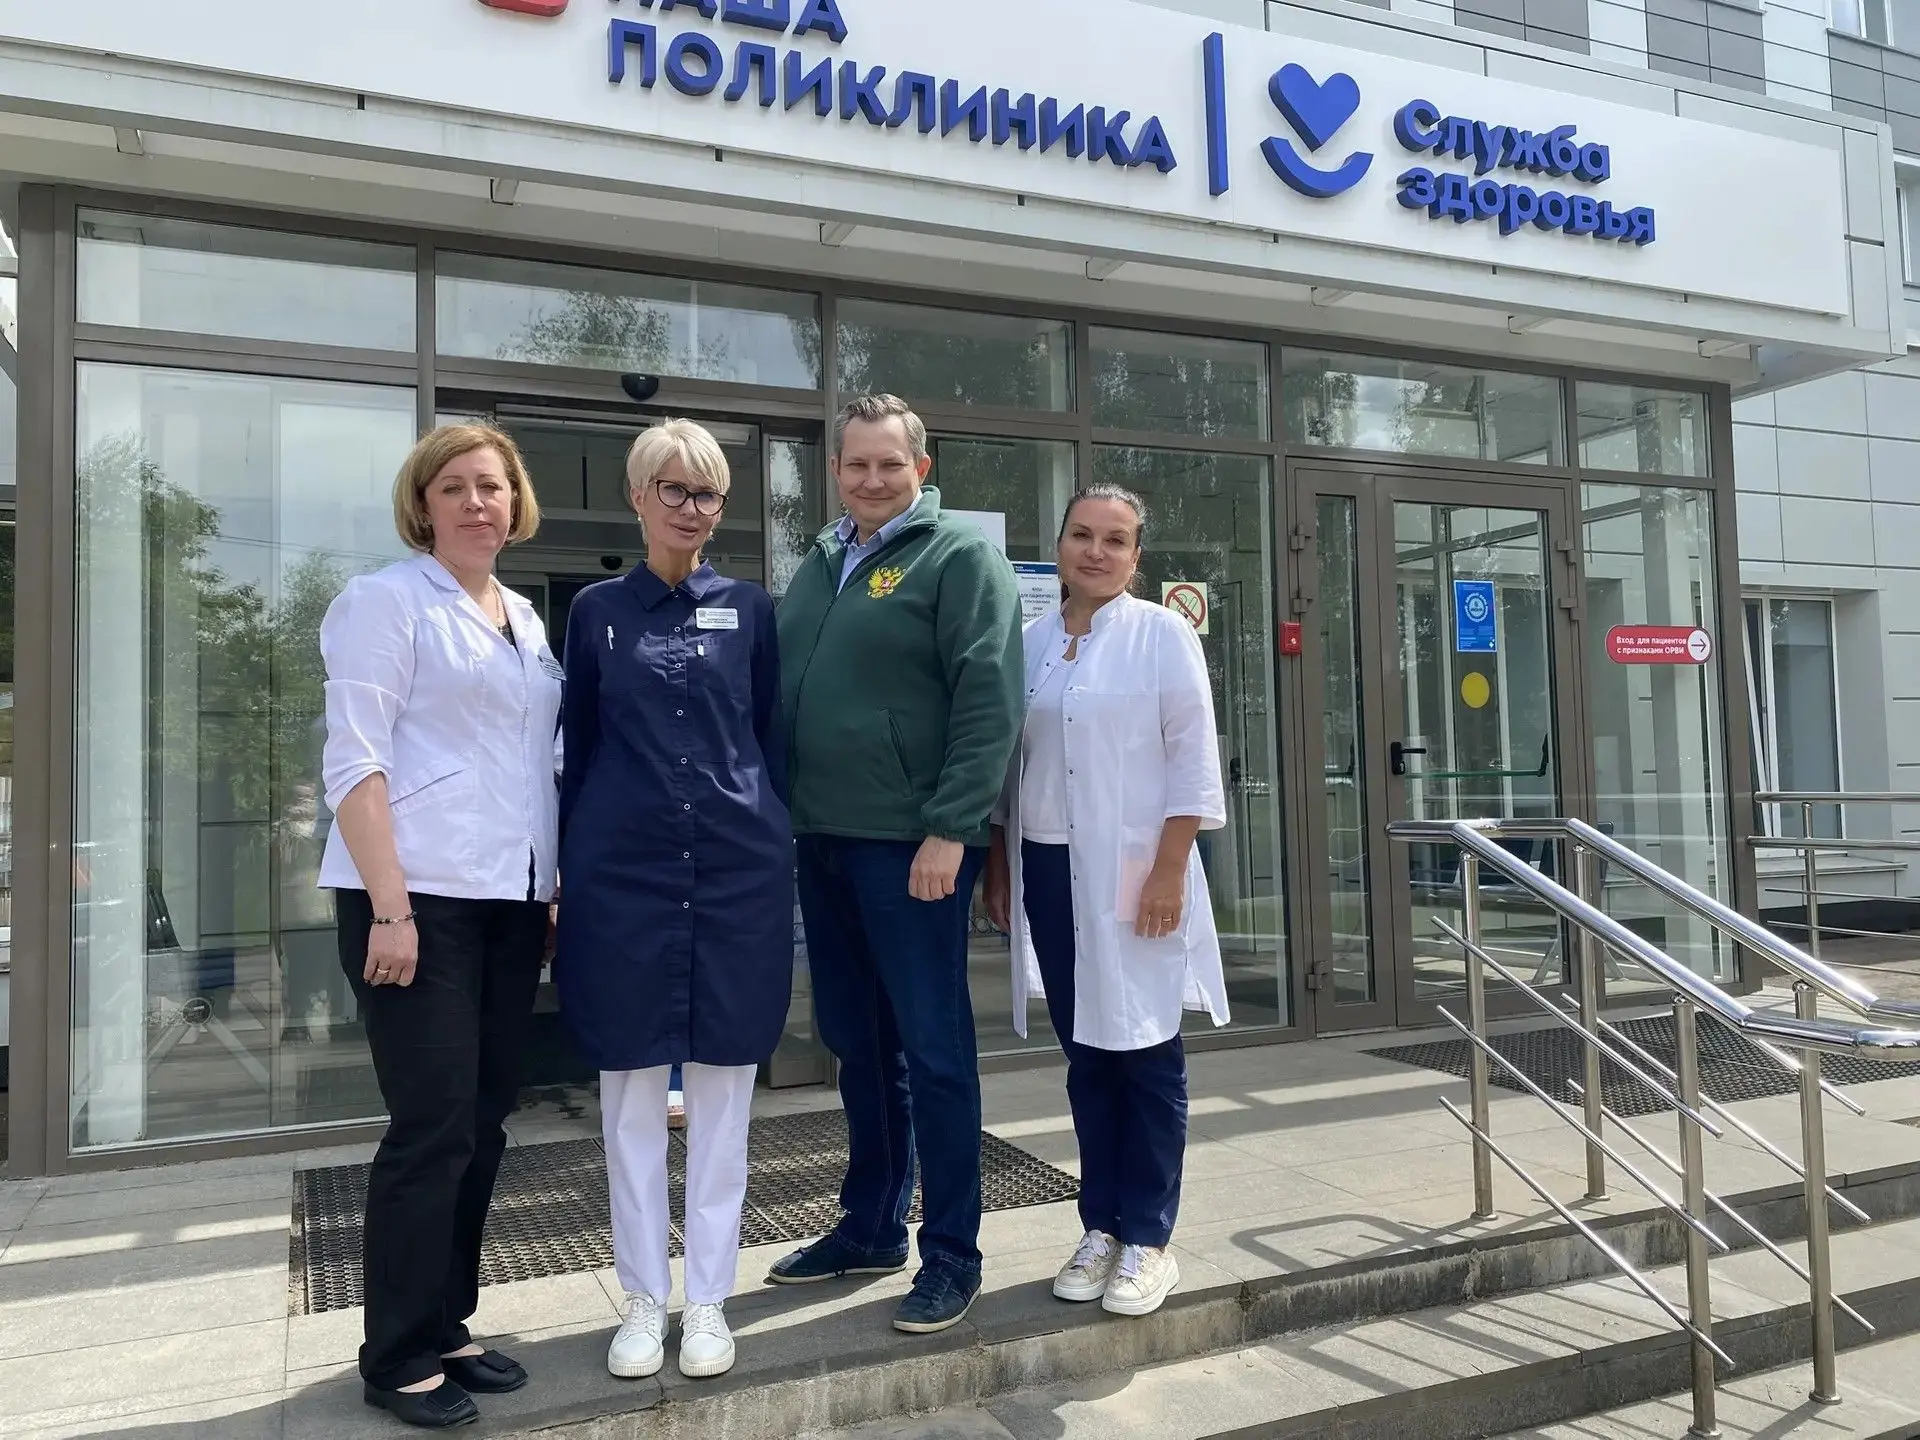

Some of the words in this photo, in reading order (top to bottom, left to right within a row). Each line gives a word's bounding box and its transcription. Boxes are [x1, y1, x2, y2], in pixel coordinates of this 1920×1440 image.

[607, 18, 1178, 175] ПОЛИКЛИНИКА
[1394, 98, 1611, 185] Служба
[1396, 167, 1655, 246] здоровья
[1616, 636, 1635, 645] Вход
[1637, 637, 1650, 645] для
[1651, 637, 1687, 645] пациентов
[1622, 647, 1664, 655] признаками
[1664, 646, 1685, 655] ОРВИ
